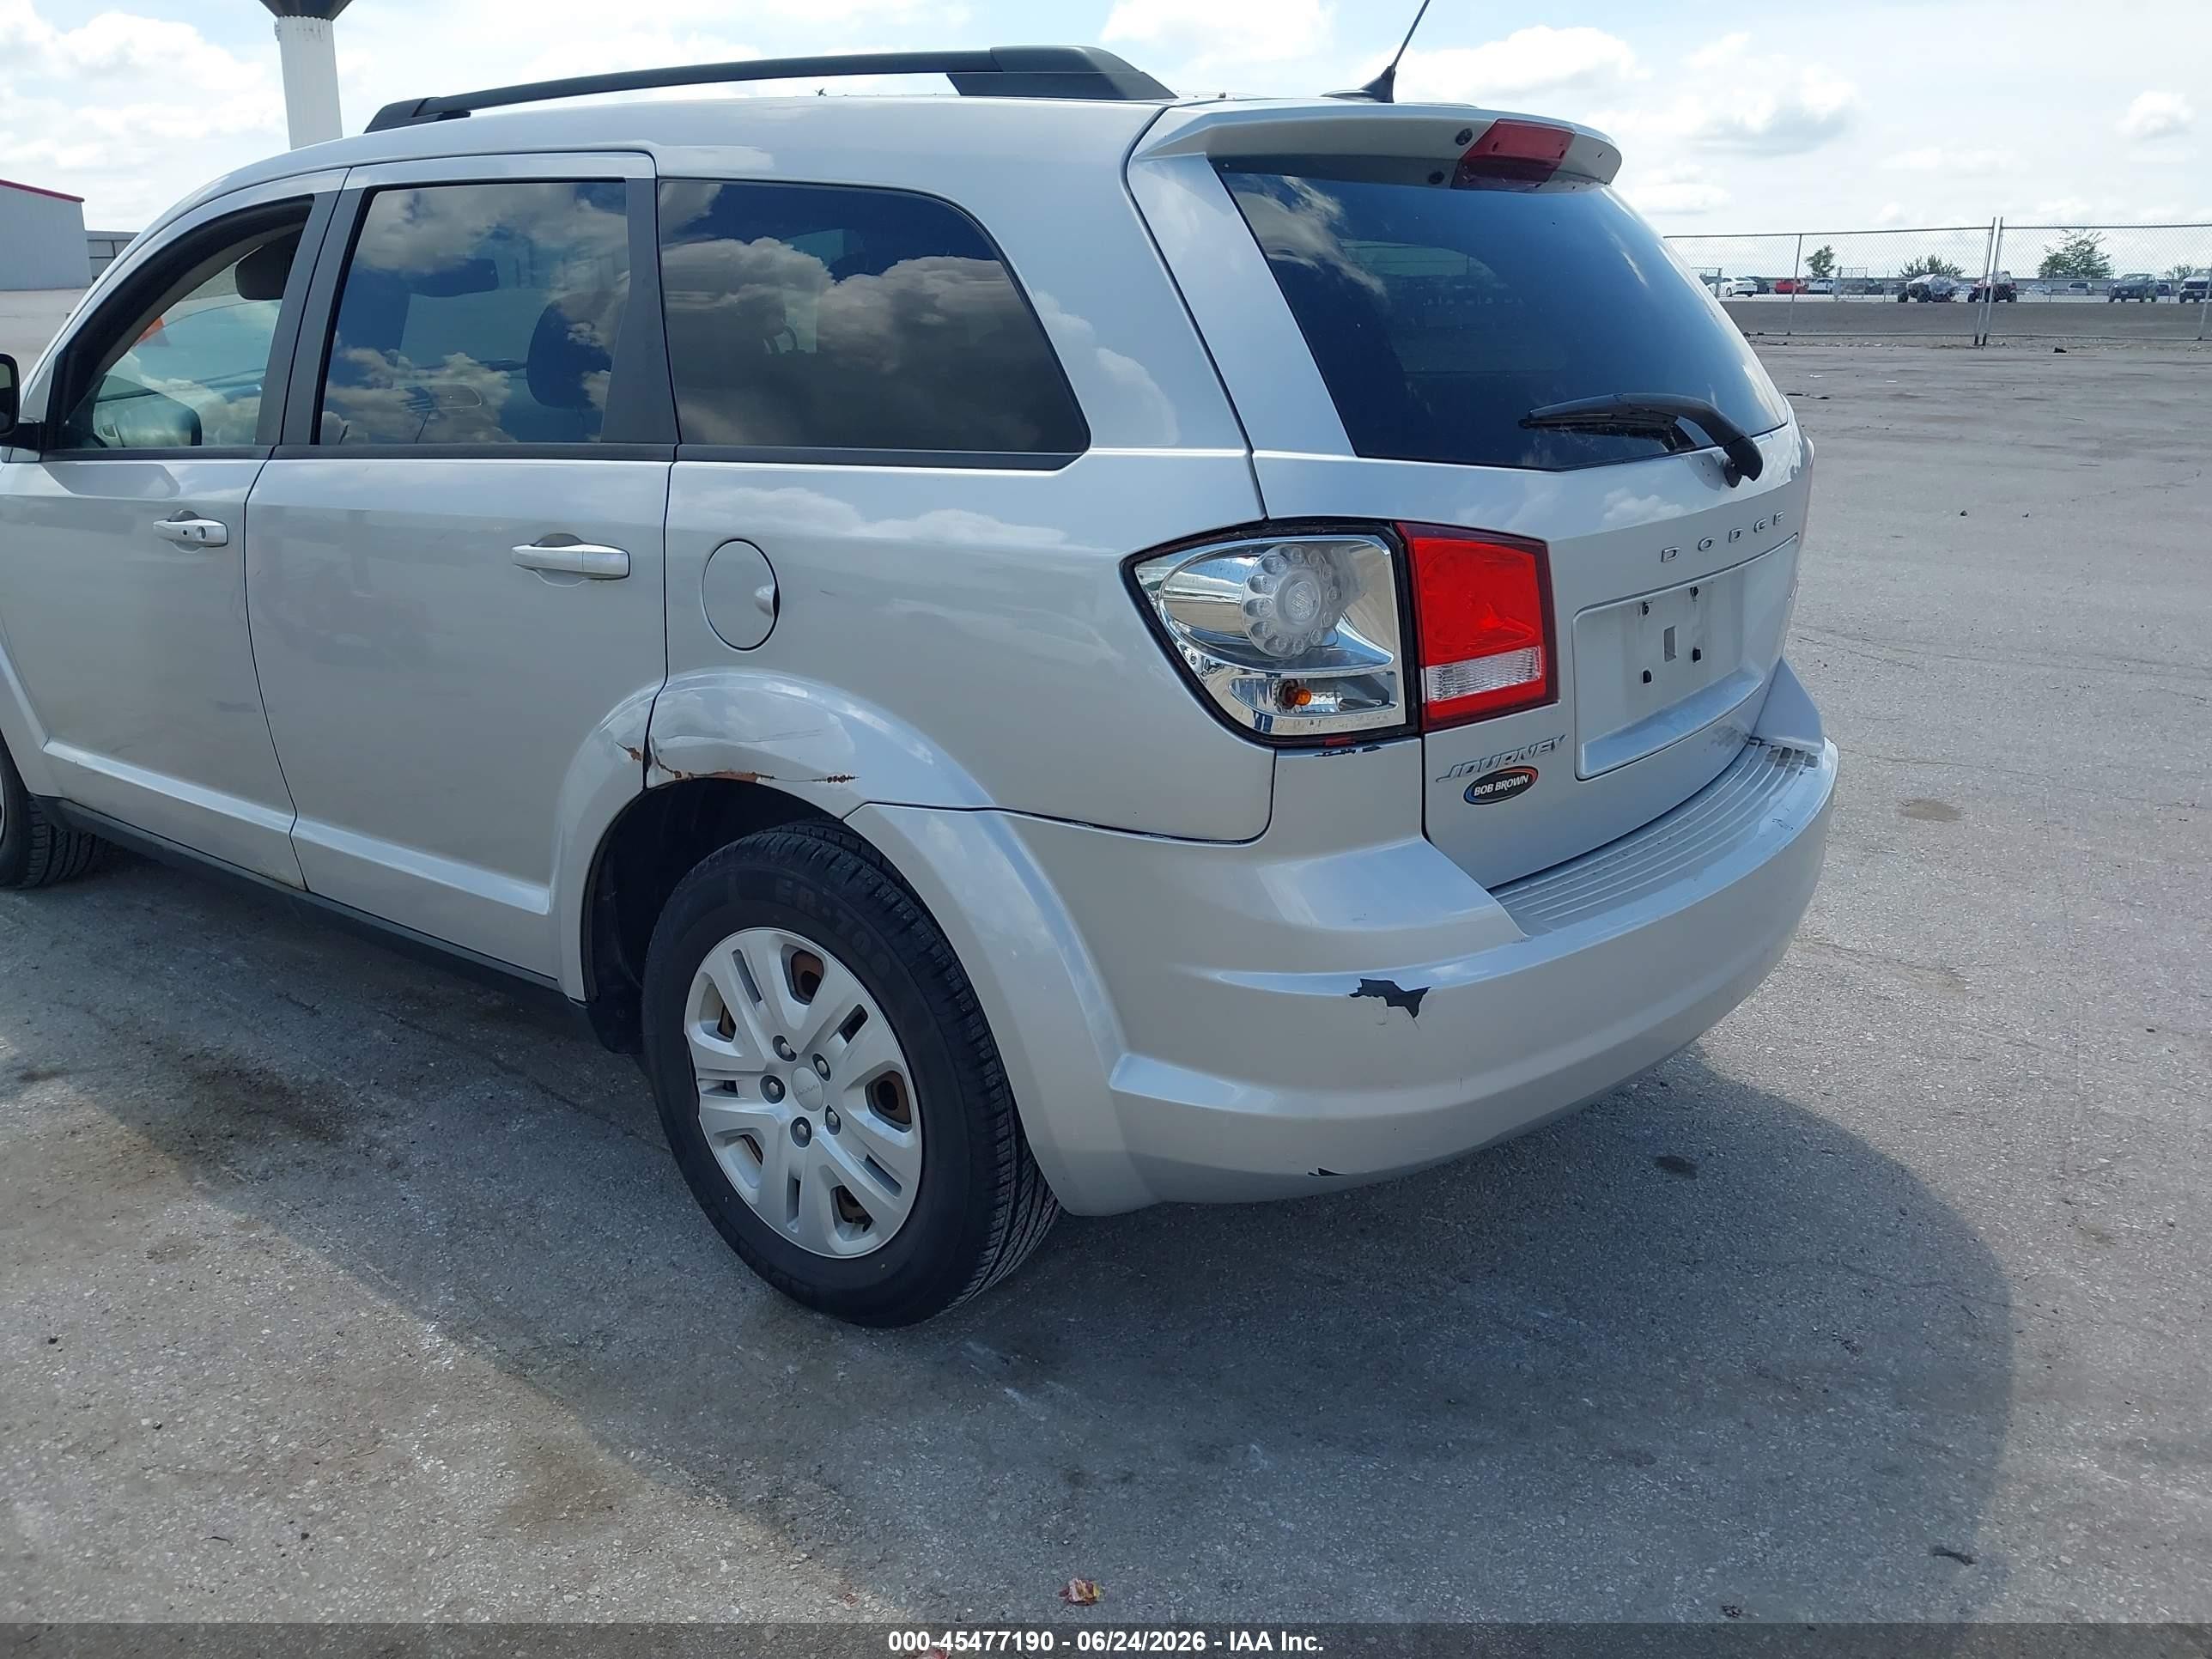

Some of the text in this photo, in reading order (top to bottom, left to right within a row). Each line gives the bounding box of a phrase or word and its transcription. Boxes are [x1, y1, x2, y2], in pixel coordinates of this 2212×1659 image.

[1661, 511, 1785, 562] DODGE
[1435, 734, 1567, 782] JOURNEY
[1474, 774, 1530, 797] BOB BROWN
